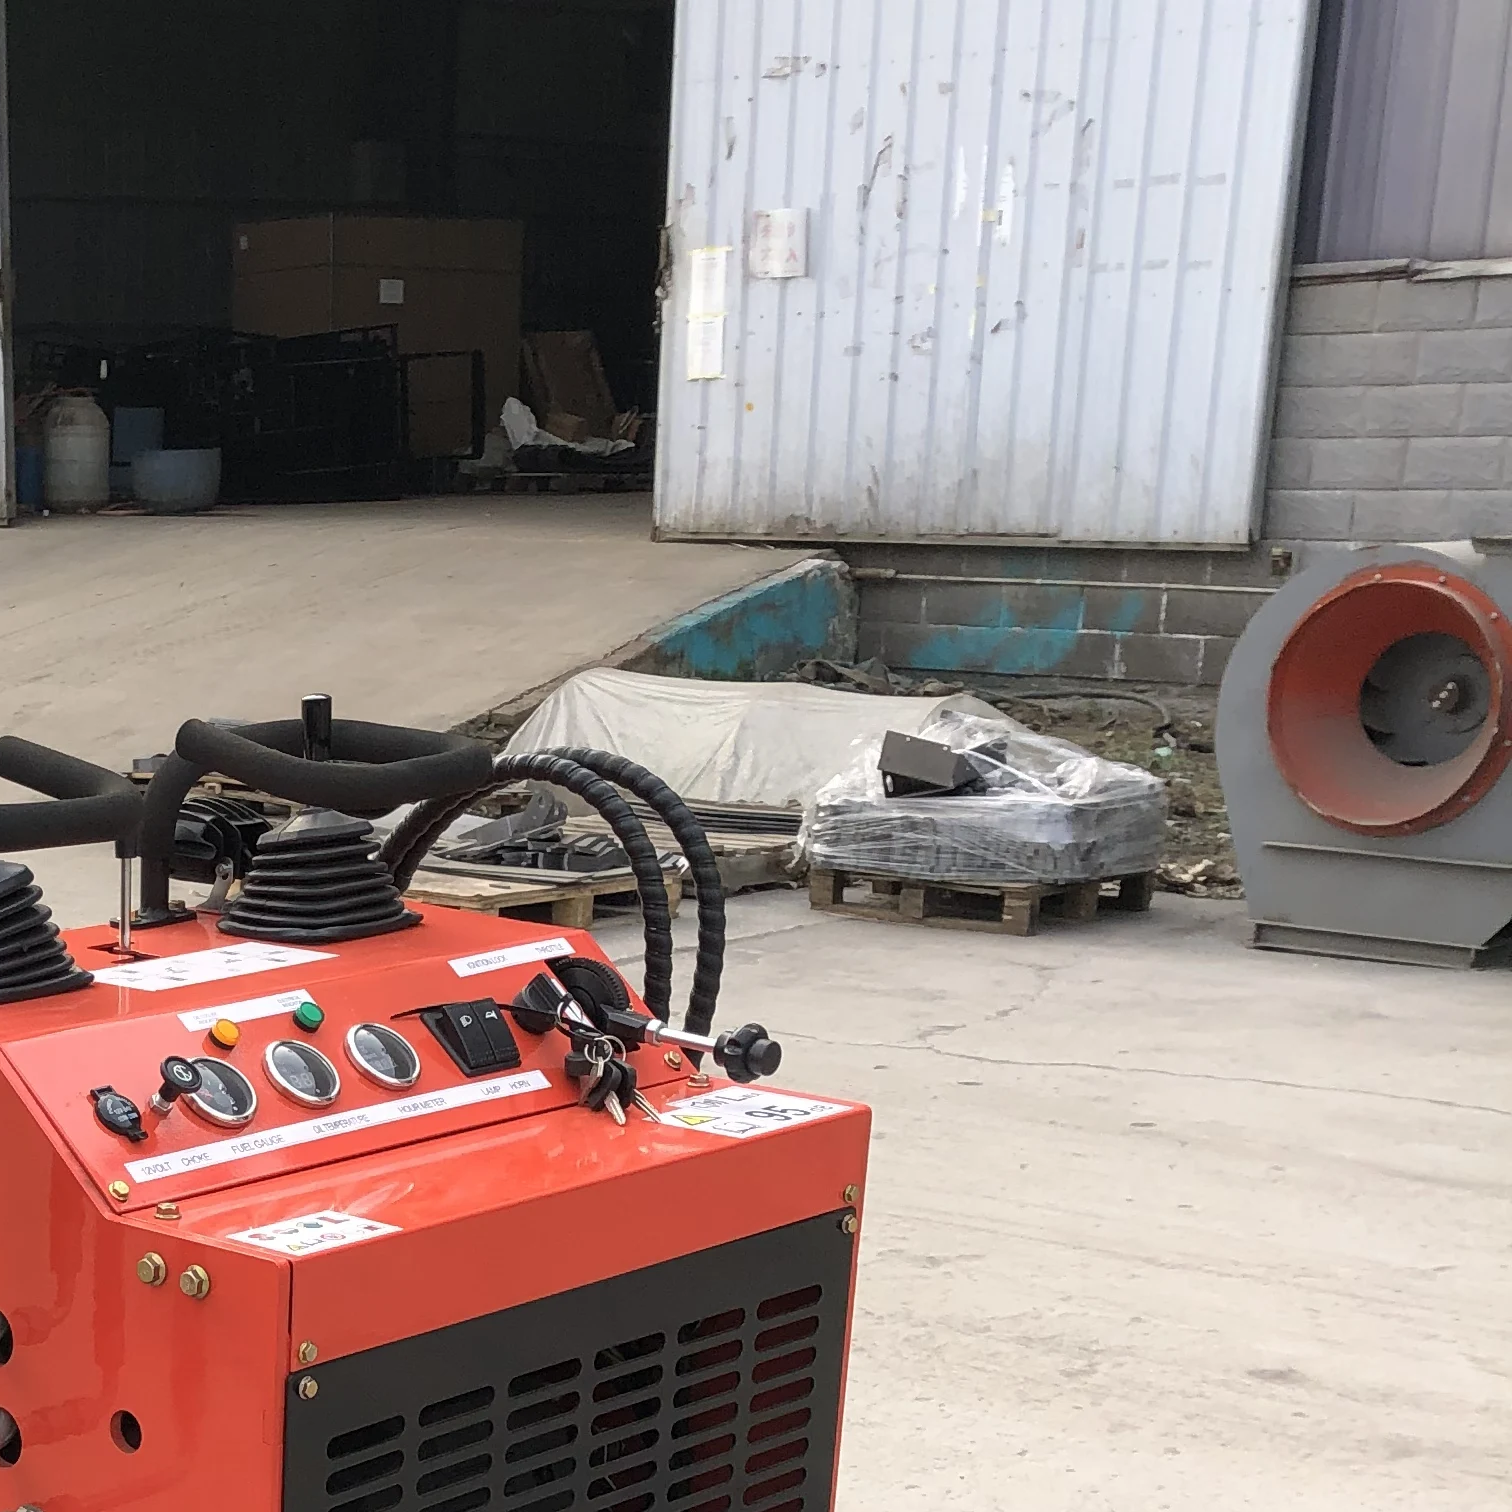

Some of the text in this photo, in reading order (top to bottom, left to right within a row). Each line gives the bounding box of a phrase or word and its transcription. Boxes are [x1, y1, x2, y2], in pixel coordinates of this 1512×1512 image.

[480, 1085, 501, 1096] LAMP
[509, 1079, 532, 1092] HORN
[397, 1097, 447, 1114] HOUR METER
[744, 1105, 811, 1121] 95
[230, 1134, 285, 1155] FUEL GAUGE
[181, 1152, 212, 1167] CHOKE
[141, 1161, 172, 1176] 12VOLT
